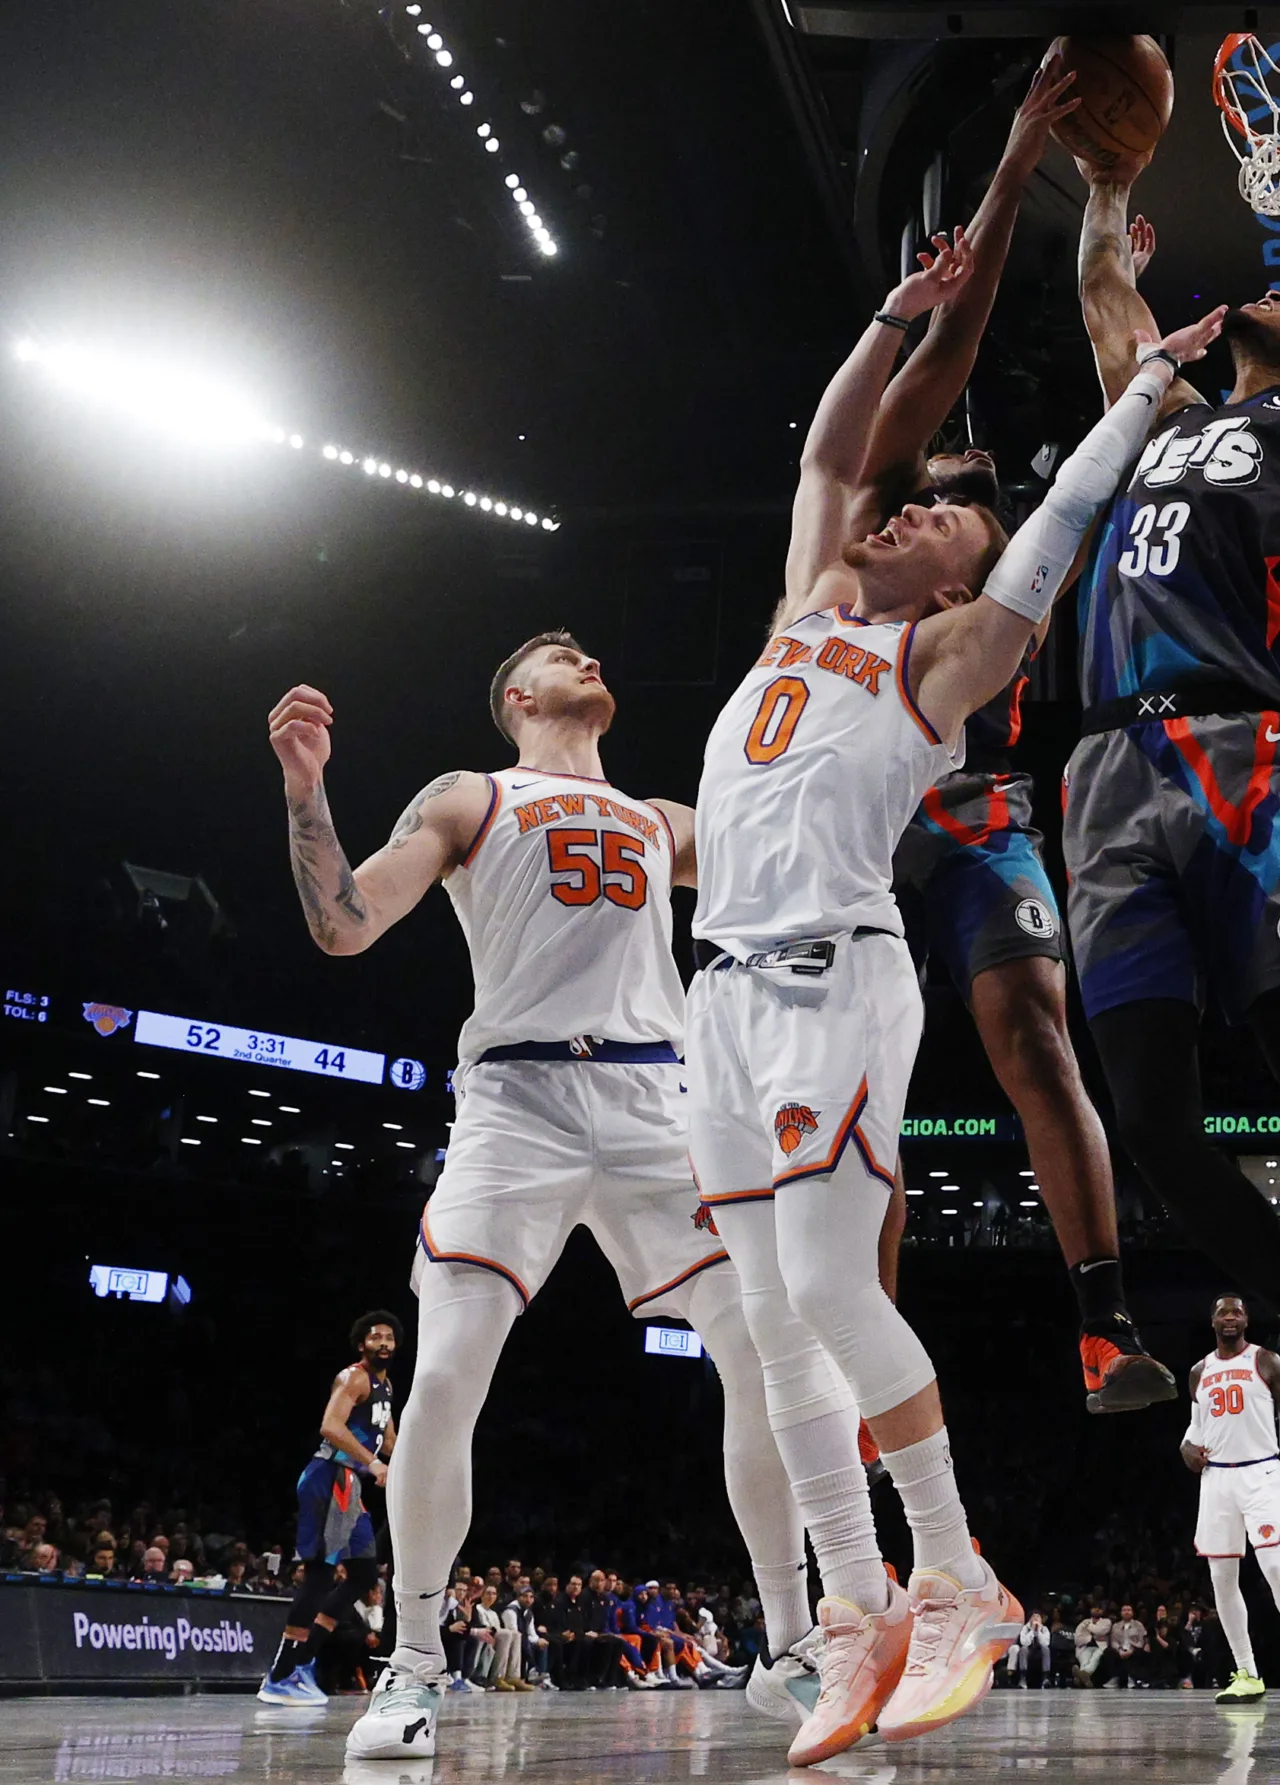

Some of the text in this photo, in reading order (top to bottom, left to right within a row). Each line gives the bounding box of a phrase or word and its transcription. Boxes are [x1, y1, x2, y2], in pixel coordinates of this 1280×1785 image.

[1117, 501, 1191, 578] 33
[758, 636, 810, 668] EW
[744, 675, 811, 766] 0
[514, 793, 660, 849] NEW YORK
[546, 828, 647, 911] 55
[40, 996, 49, 1006] 3
[38, 1011, 47, 1022] 6
[186, 1025, 221, 1050] 52
[247, 1035, 285, 1055] 3:31
[233, 1049, 292, 1067] 2nd Quarter
[314, 1049, 346, 1073] 44
[901, 1119, 996, 1136] GIOA.COM
[1209, 1384, 1244, 1417] 30
